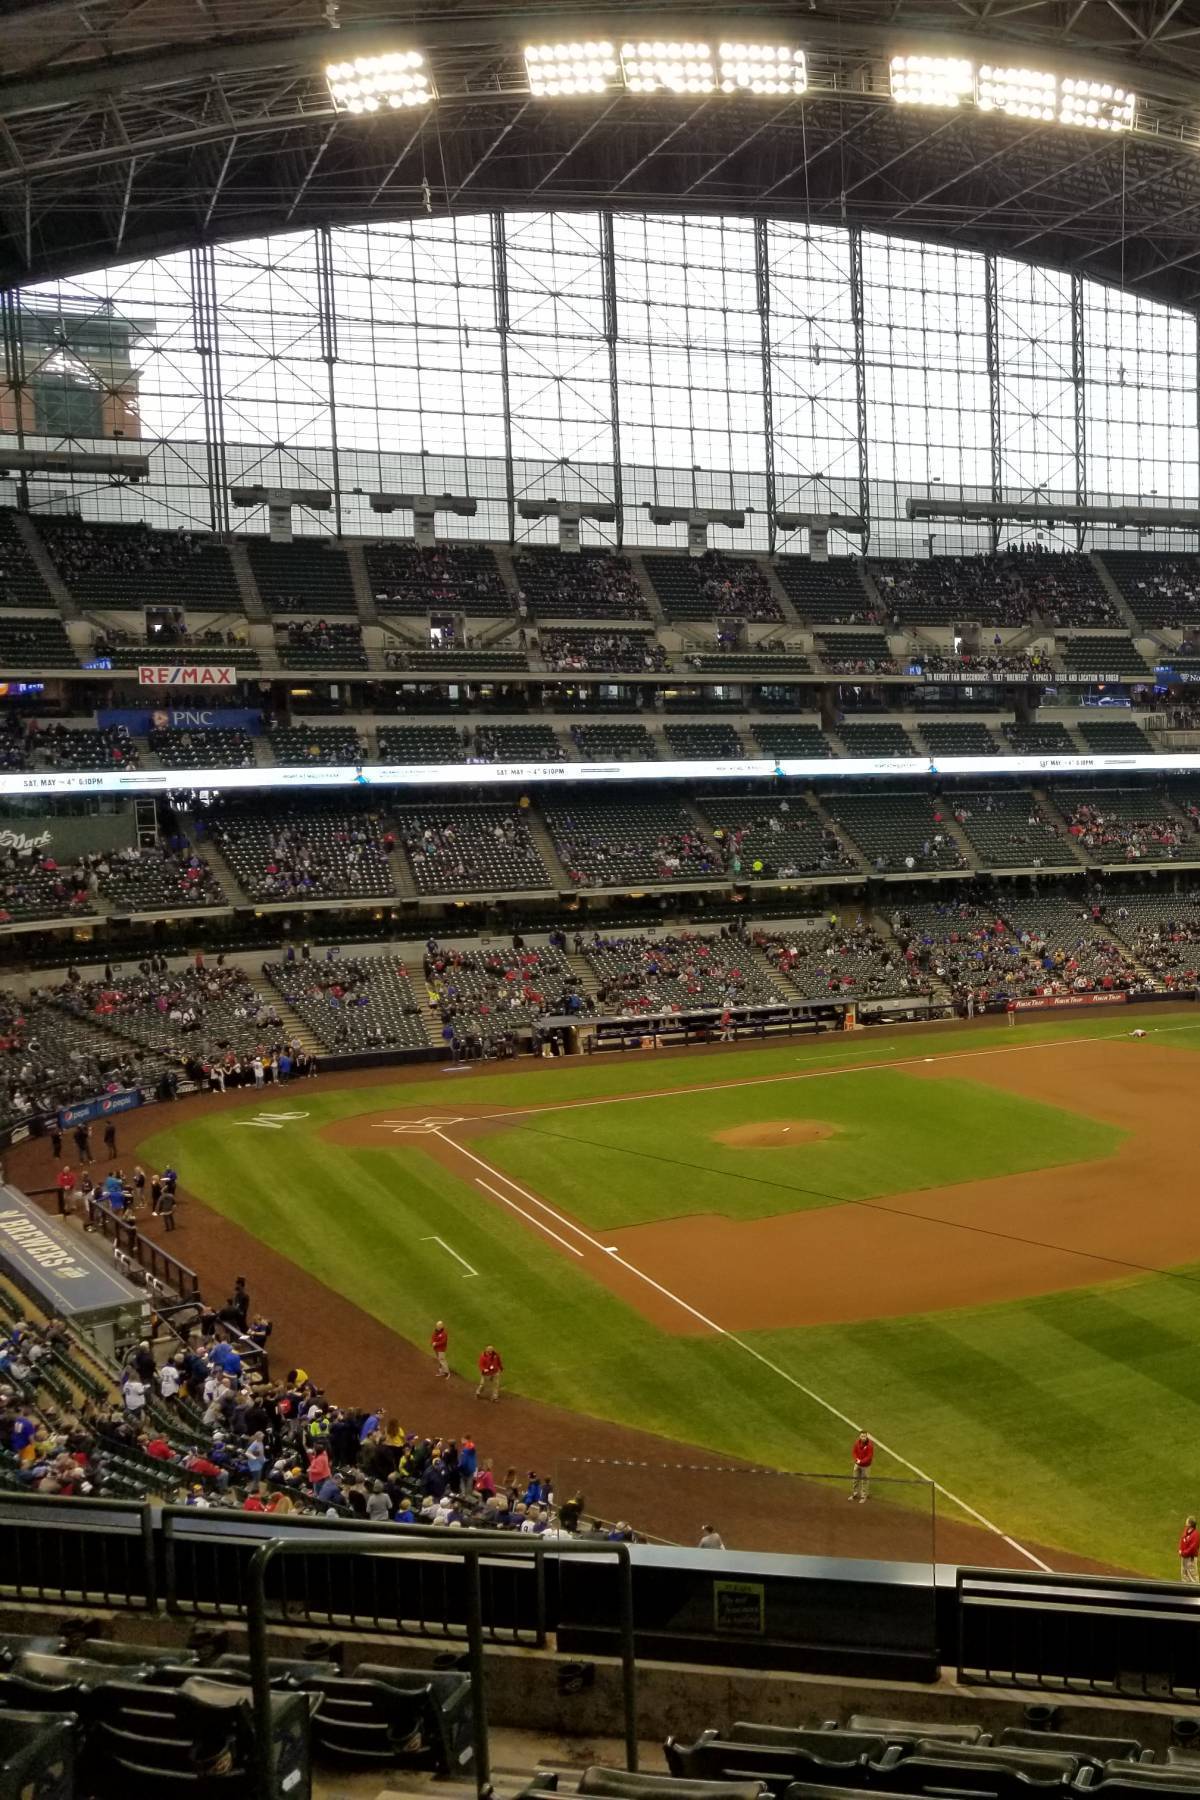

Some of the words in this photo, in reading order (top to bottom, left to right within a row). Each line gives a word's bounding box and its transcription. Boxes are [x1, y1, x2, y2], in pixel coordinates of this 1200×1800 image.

[141, 668, 231, 684] RE/MAX
[172, 711, 213, 725] PNC
[41, 779, 56, 787] MAY
[113, 1097, 131, 1108] pepsi
[0, 1218, 76, 1268] BREWERS
